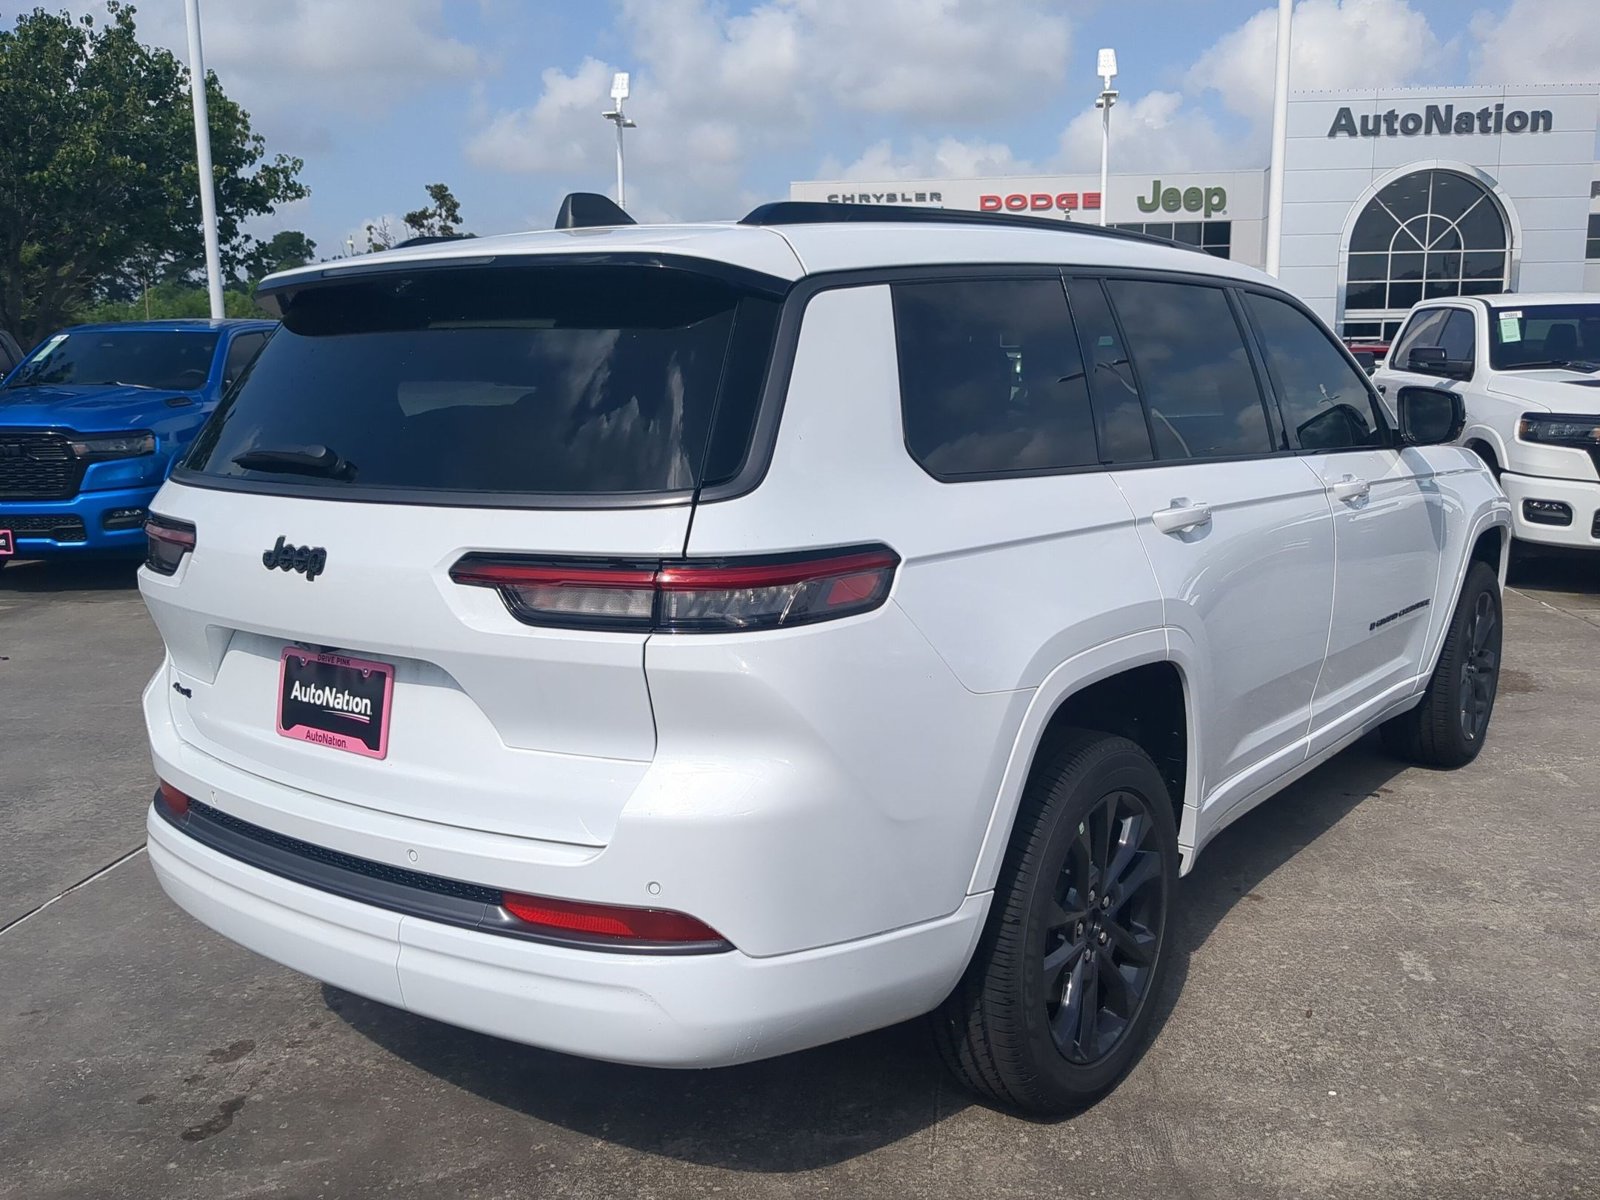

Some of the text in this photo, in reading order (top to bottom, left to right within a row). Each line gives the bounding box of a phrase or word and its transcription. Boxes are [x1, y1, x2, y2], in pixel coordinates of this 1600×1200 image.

[1327, 103, 1553, 138] AutoNation
[827, 192, 942, 204] CHRYSLER
[980, 192, 1101, 212] DODGE
[1137, 180, 1226, 218] Jeep
[262, 535, 327, 582] Jeep
[317, 654, 351, 666] DRIVE PINK
[290, 680, 372, 715] AutoNation
[305, 729, 348, 748] AutoNation
